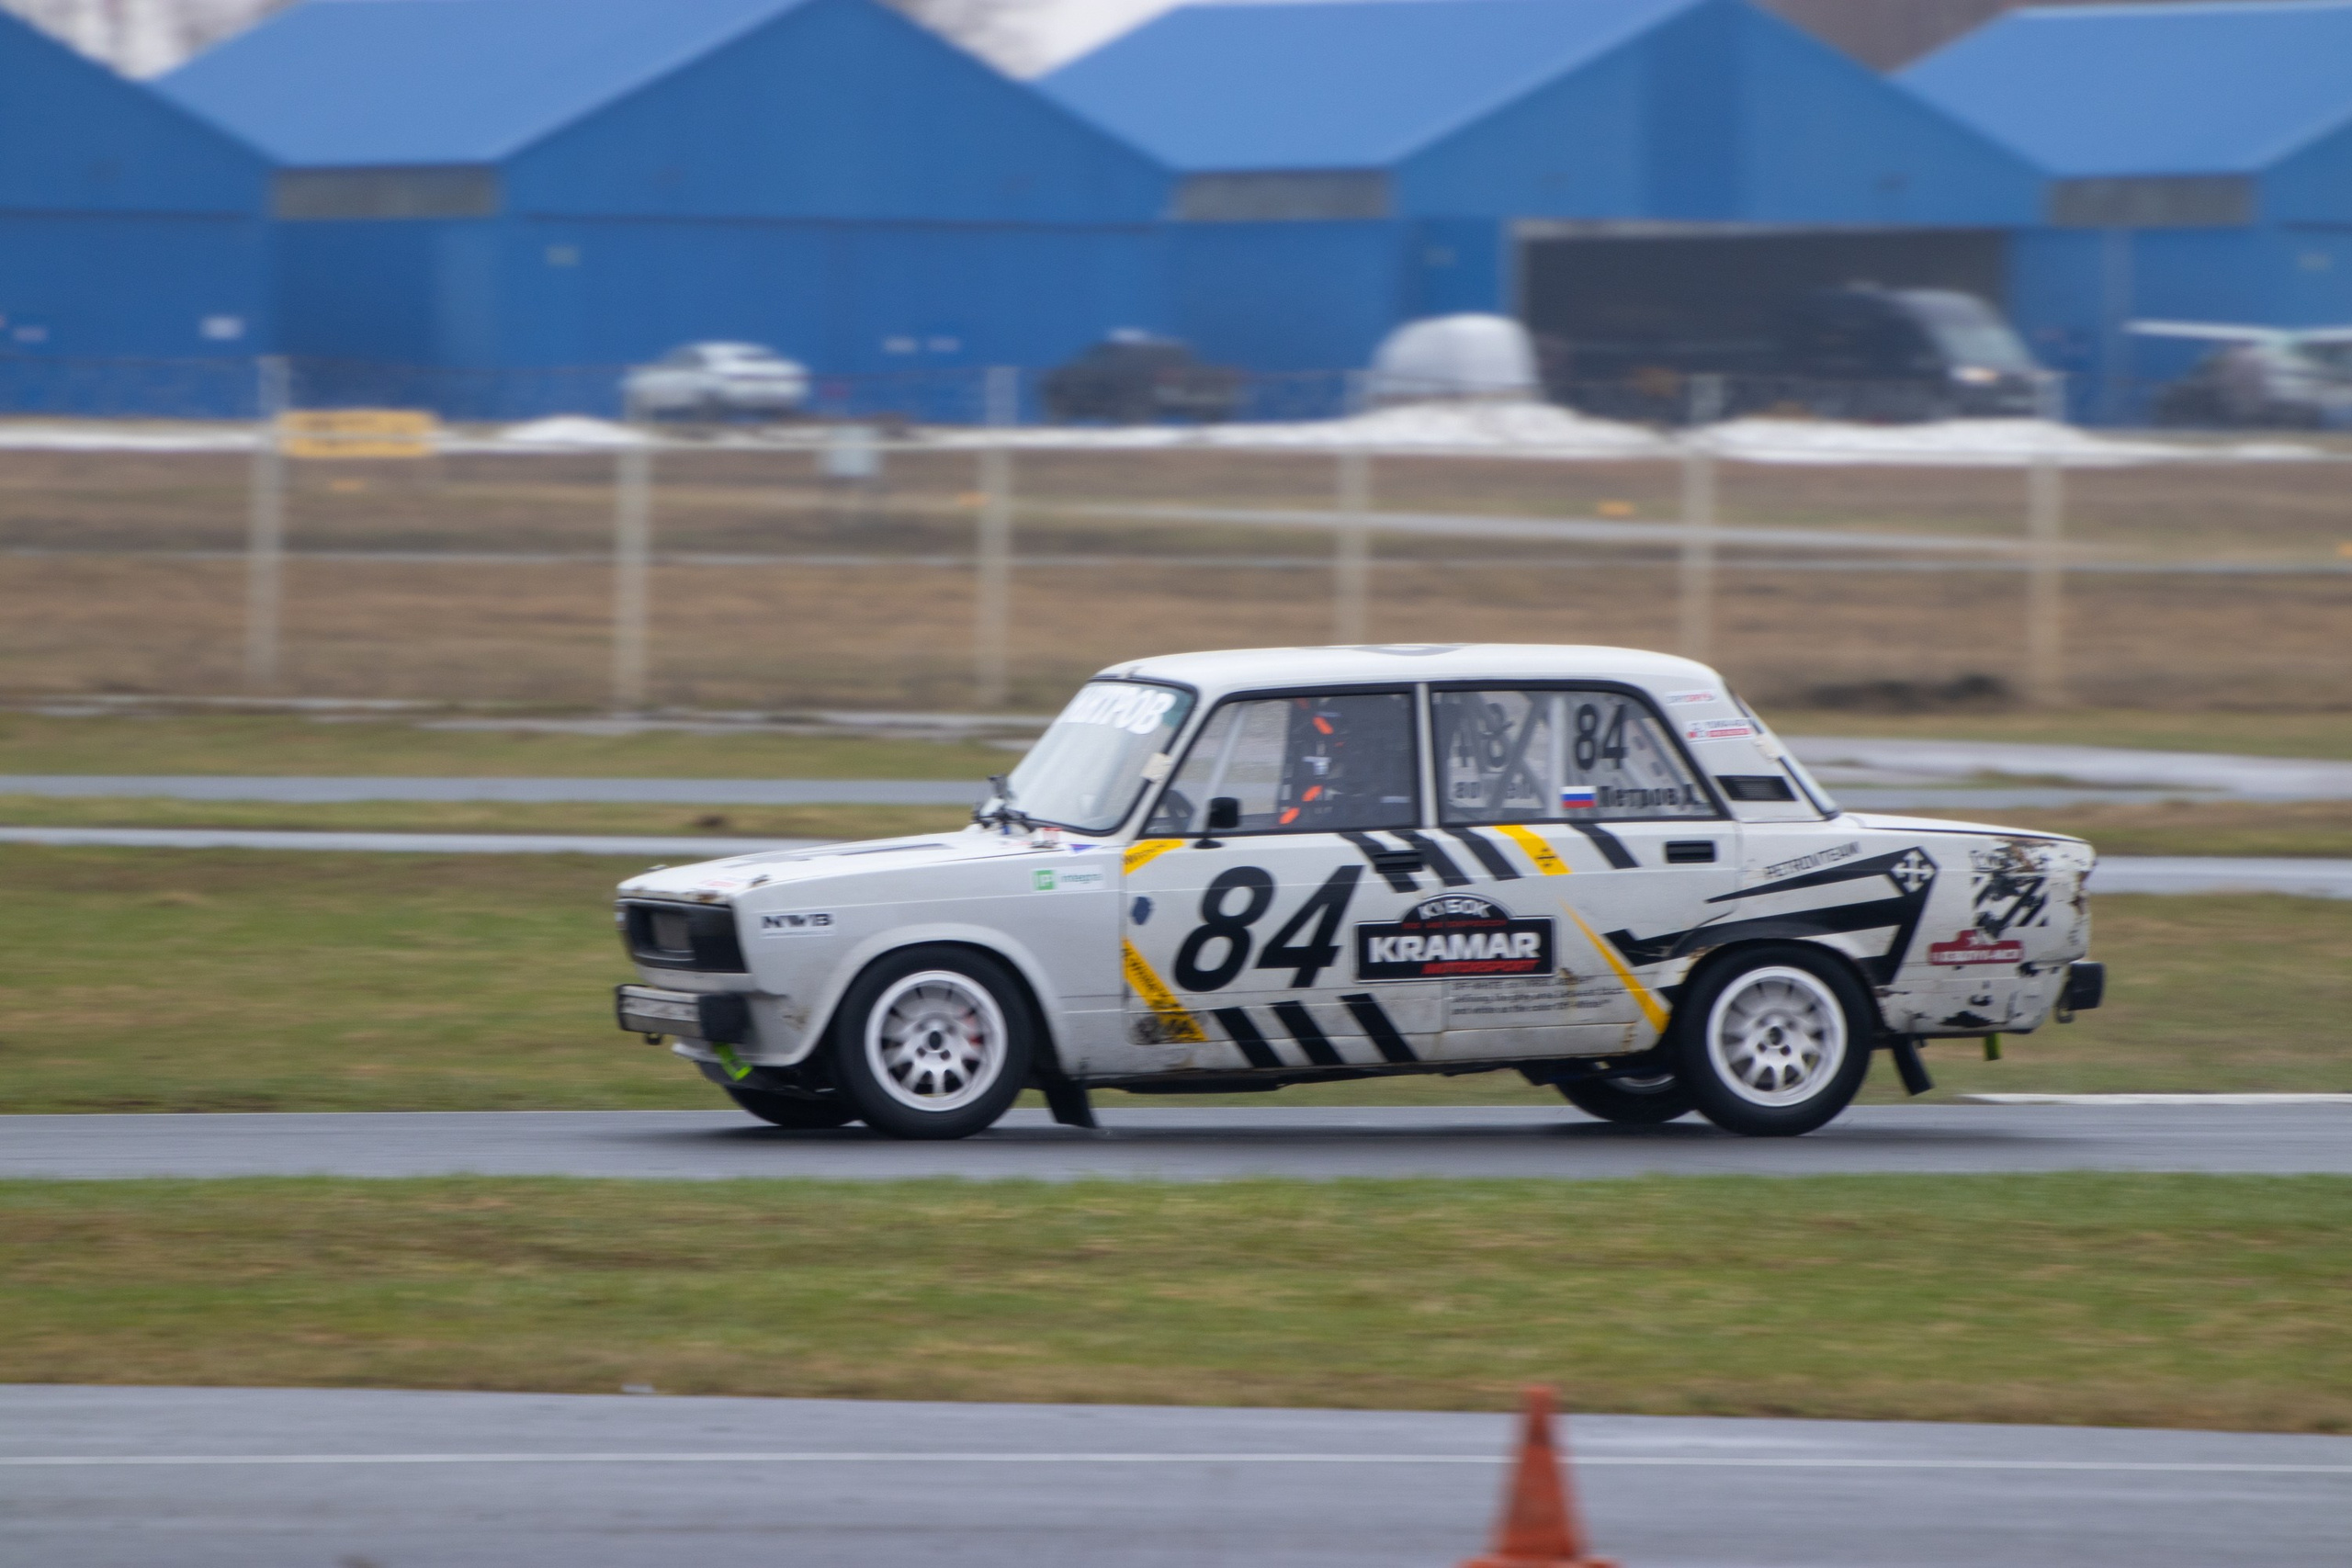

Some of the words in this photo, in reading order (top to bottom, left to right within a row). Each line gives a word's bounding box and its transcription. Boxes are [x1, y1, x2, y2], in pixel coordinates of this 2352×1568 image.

[1575, 703, 1627, 771] 84
[761, 913, 833, 929] NWB
[1173, 865, 1366, 992] 84
[1368, 932, 1541, 964] KRAMAR
